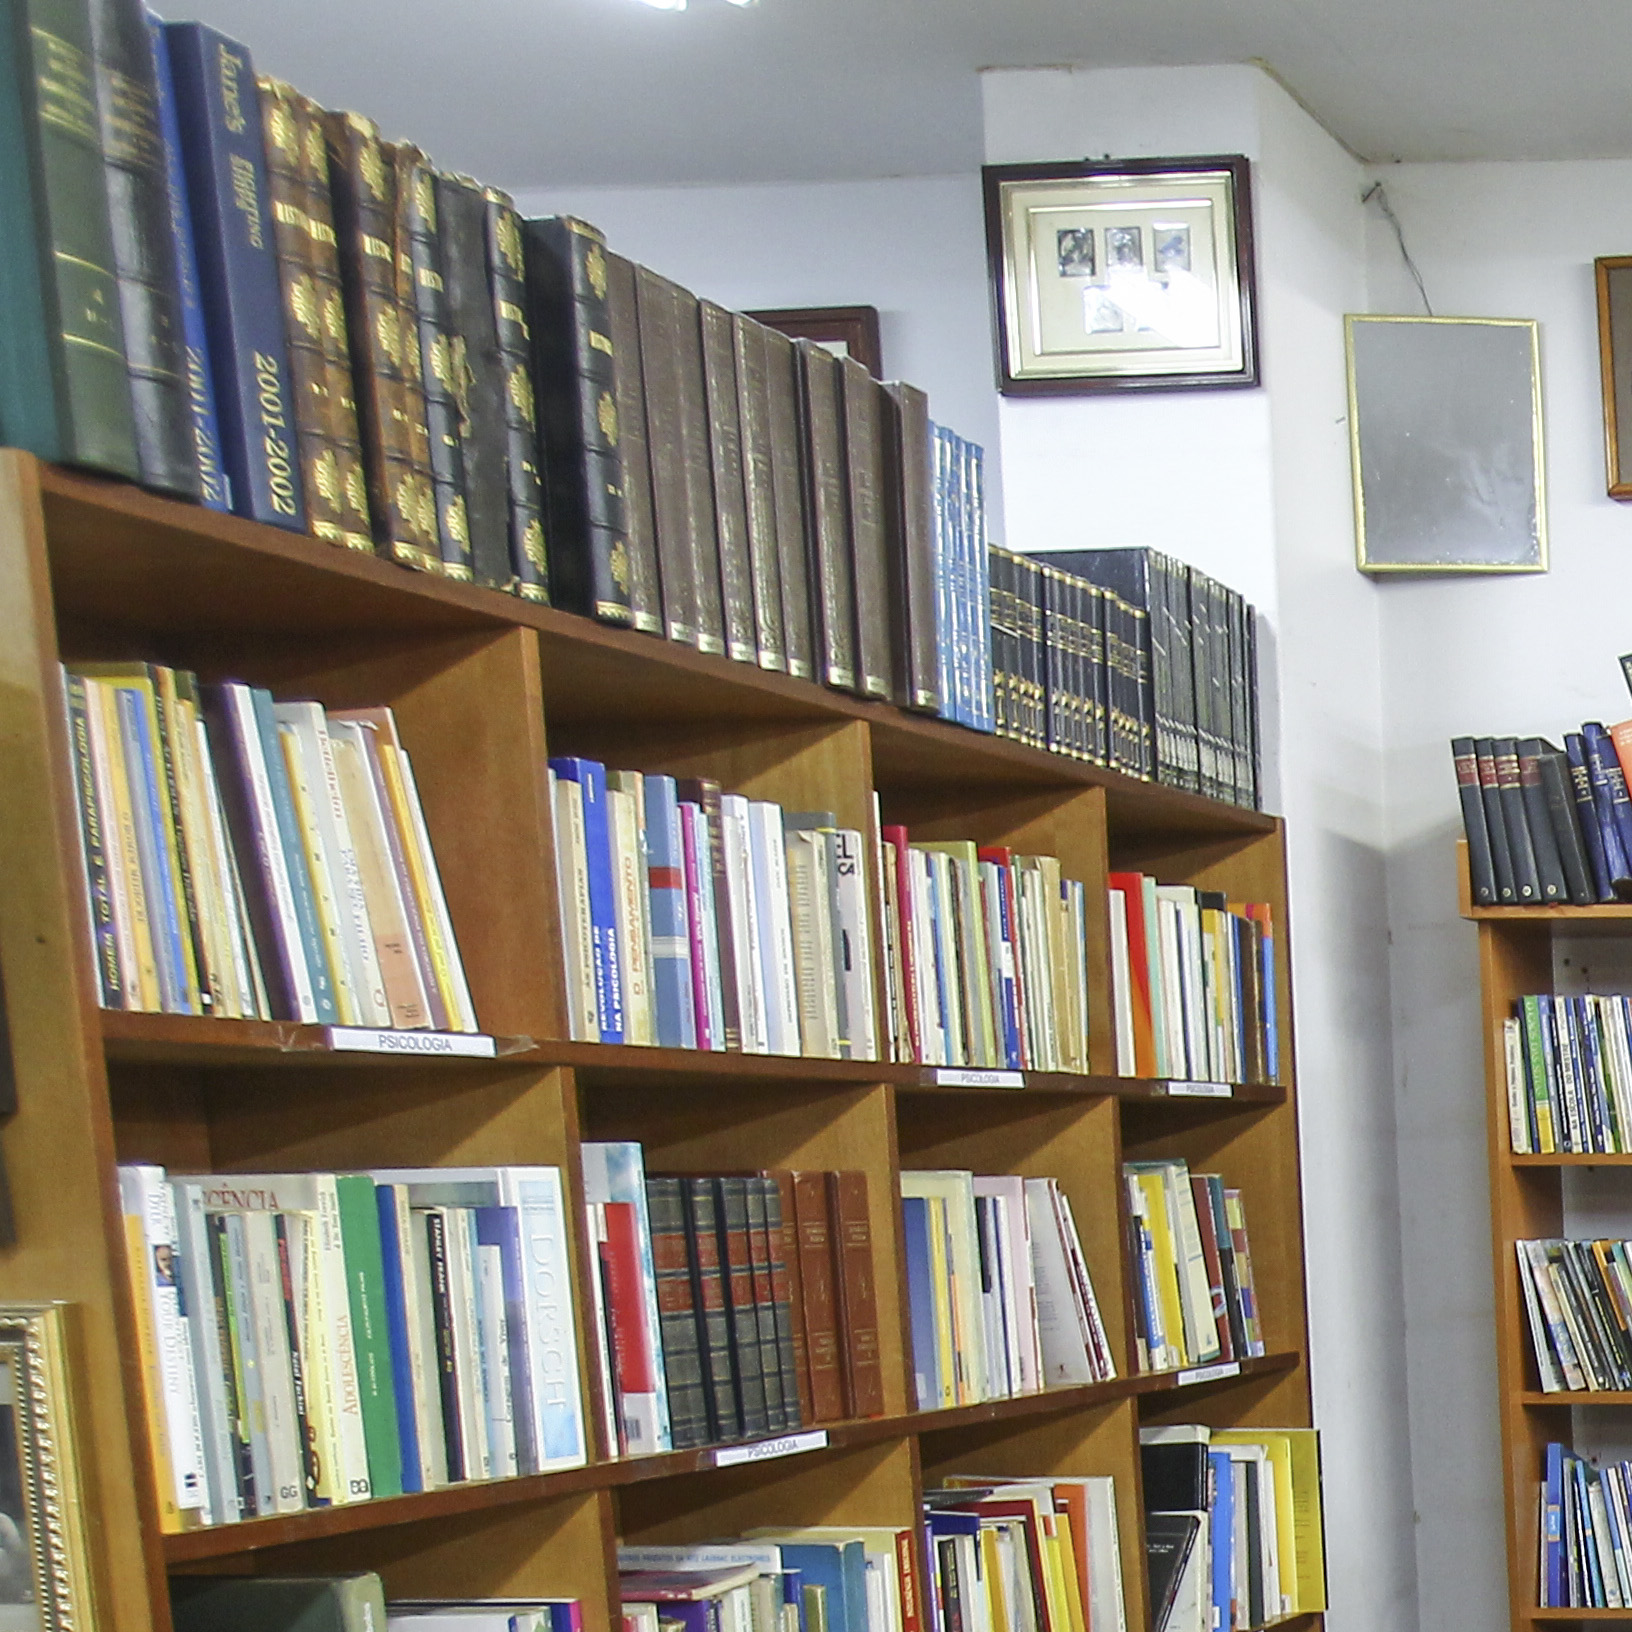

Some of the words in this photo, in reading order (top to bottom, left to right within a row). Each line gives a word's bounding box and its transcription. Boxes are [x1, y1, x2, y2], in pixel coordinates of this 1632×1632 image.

[218, 44, 246, 135] Jane's
[254, 351, 296, 517] 2001-2002
[378, 1034, 453, 1052] PSICOLOGIA
[530, 1232, 569, 1410] DORSCH
[748, 1438, 798, 1459] PSICOLOGIA
